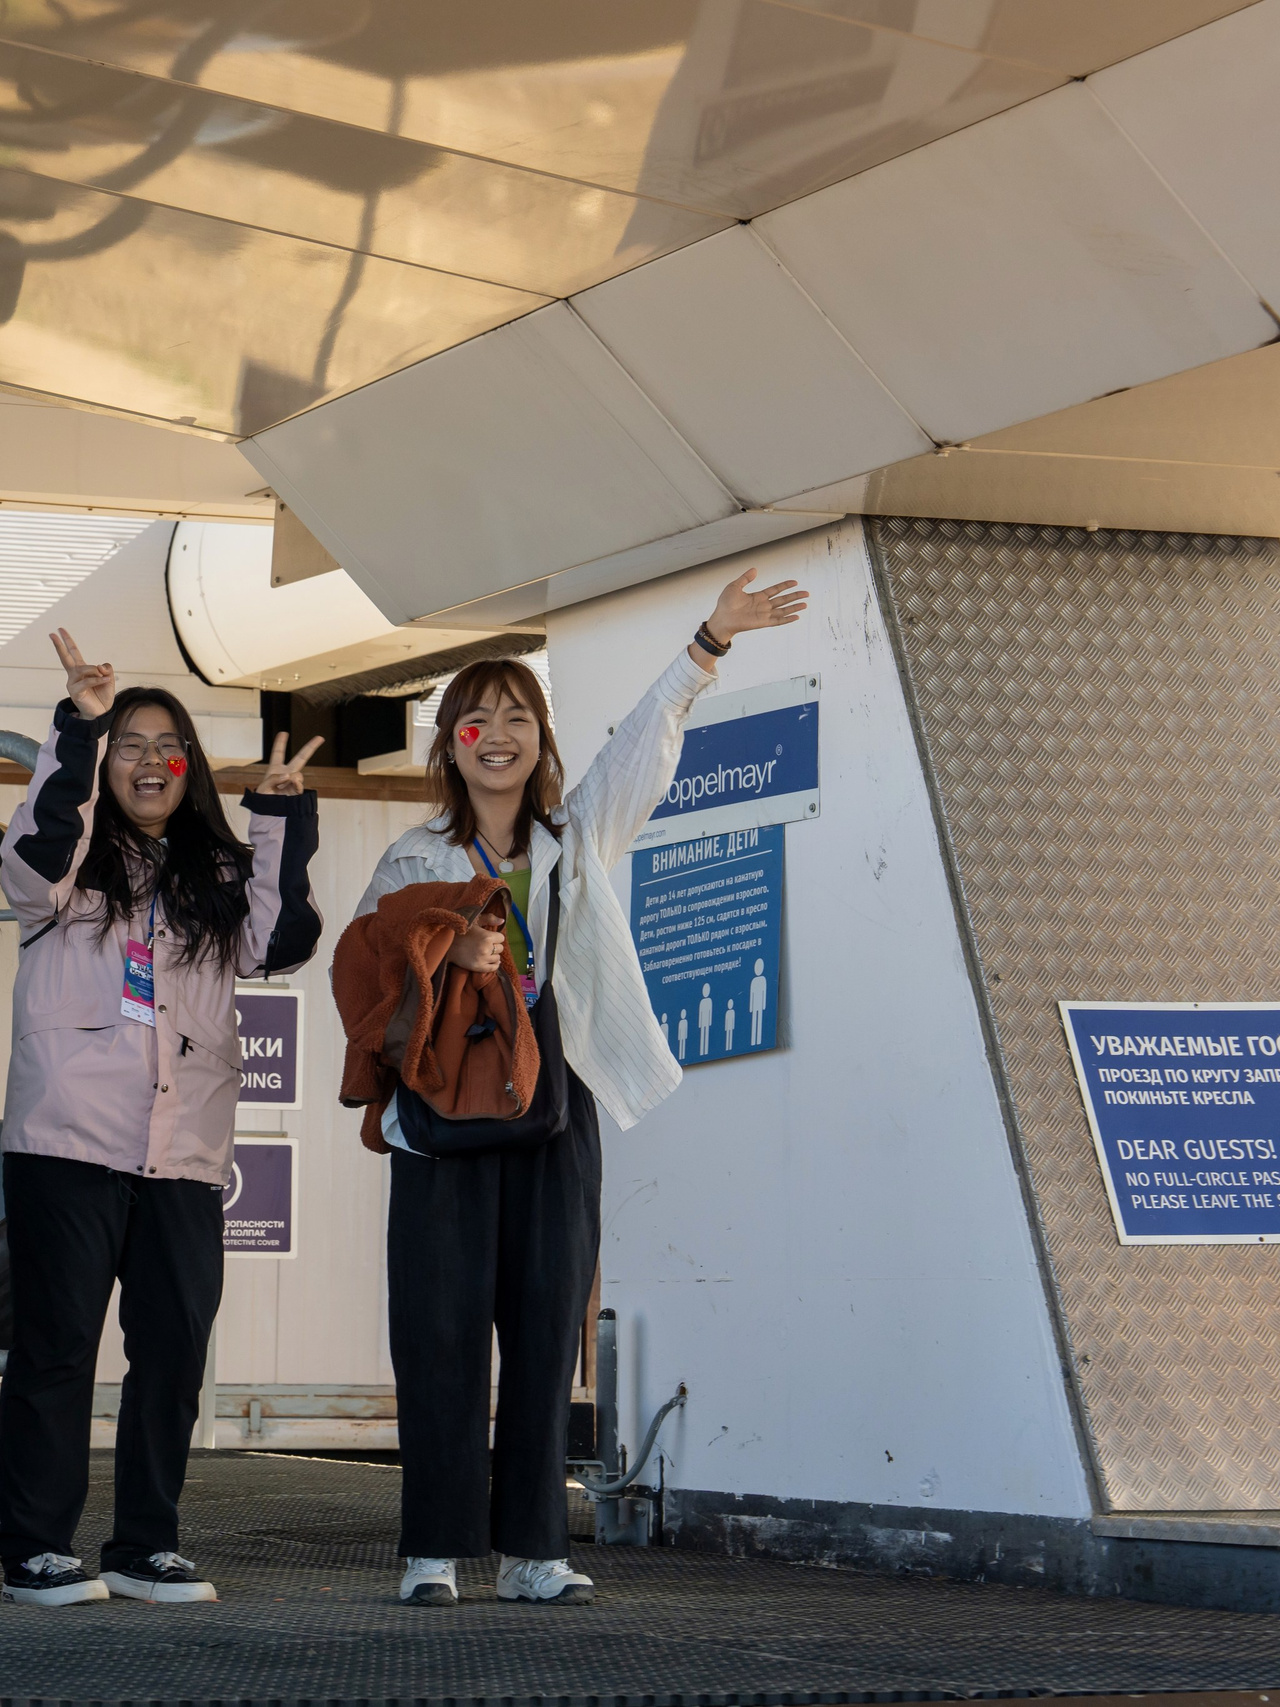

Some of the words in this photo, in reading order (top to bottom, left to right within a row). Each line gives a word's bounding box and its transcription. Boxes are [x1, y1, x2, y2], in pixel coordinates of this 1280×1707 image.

[652, 837, 724, 873] ВНИМАНИЕ,
[727, 828, 759, 857] ДЕТИ
[645, 896, 659, 908] Дети
[660, 895, 667, 904] до
[668, 890, 676, 900] 14
[676, 889, 687, 899] лет
[687, 879, 725, 898] допускаются
[726, 877, 734, 885] на
[735, 869, 764, 884] канатную
[640, 912, 659, 926] дорогу
[660, 904, 682, 918] ТОЛЬКО
[687, 893, 734, 912] сопровождении
[736, 885, 769, 900] взрослого.
[640, 930, 655, 943] Дети,
[656, 925, 676, 938] ростом
[677, 921, 693, 931] ниже
[694, 915, 705, 927] 125
[717, 907, 740, 922] садятся
[746, 902, 768, 916] кресло
[639, 941, 665, 957] канатной
[666, 938, 686, 952] дороги
[687, 931, 710, 945] ТОЛЬКО
[711, 929, 729, 942] рядом
[735, 920, 768, 935] взрослым.
[643, 953, 693, 972] Заблаговременно
[694, 947, 726, 960] готовьтесь
[732, 938, 756, 952] посадке
[662, 965, 713, 984] соответствующем
[714, 957, 741, 973] порядке!
[1090, 1035, 1243, 1056] УВАЖАЕМЫЕ
[1246, 1035, 1280, 1056] ГО
[1098, 1068, 1164, 1086] ПРОЕЗД
[1166, 1068, 1189, 1083] ПО
[1191, 1068, 1240, 1083] КРУГУ
[1104, 1090, 1190, 1105] ПОКИНЬТЕ
[1193, 1090, 1256, 1105] КРЕСЛА
[1117, 1139, 1179, 1160] DEAR
[1183, 1139, 1278, 1160] GUESTS!
[1125, 1172, 1150, 1187] NO
[1153, 1171, 1250, 1187] FULL-CIRCLE
[1131, 1194, 1190, 1209] PLEASE
[1192, 1194, 1240, 1208] LEAVE
[1241, 1193, 1275, 1208] THE
[230, 1229, 266, 1237] КОЛПАК
